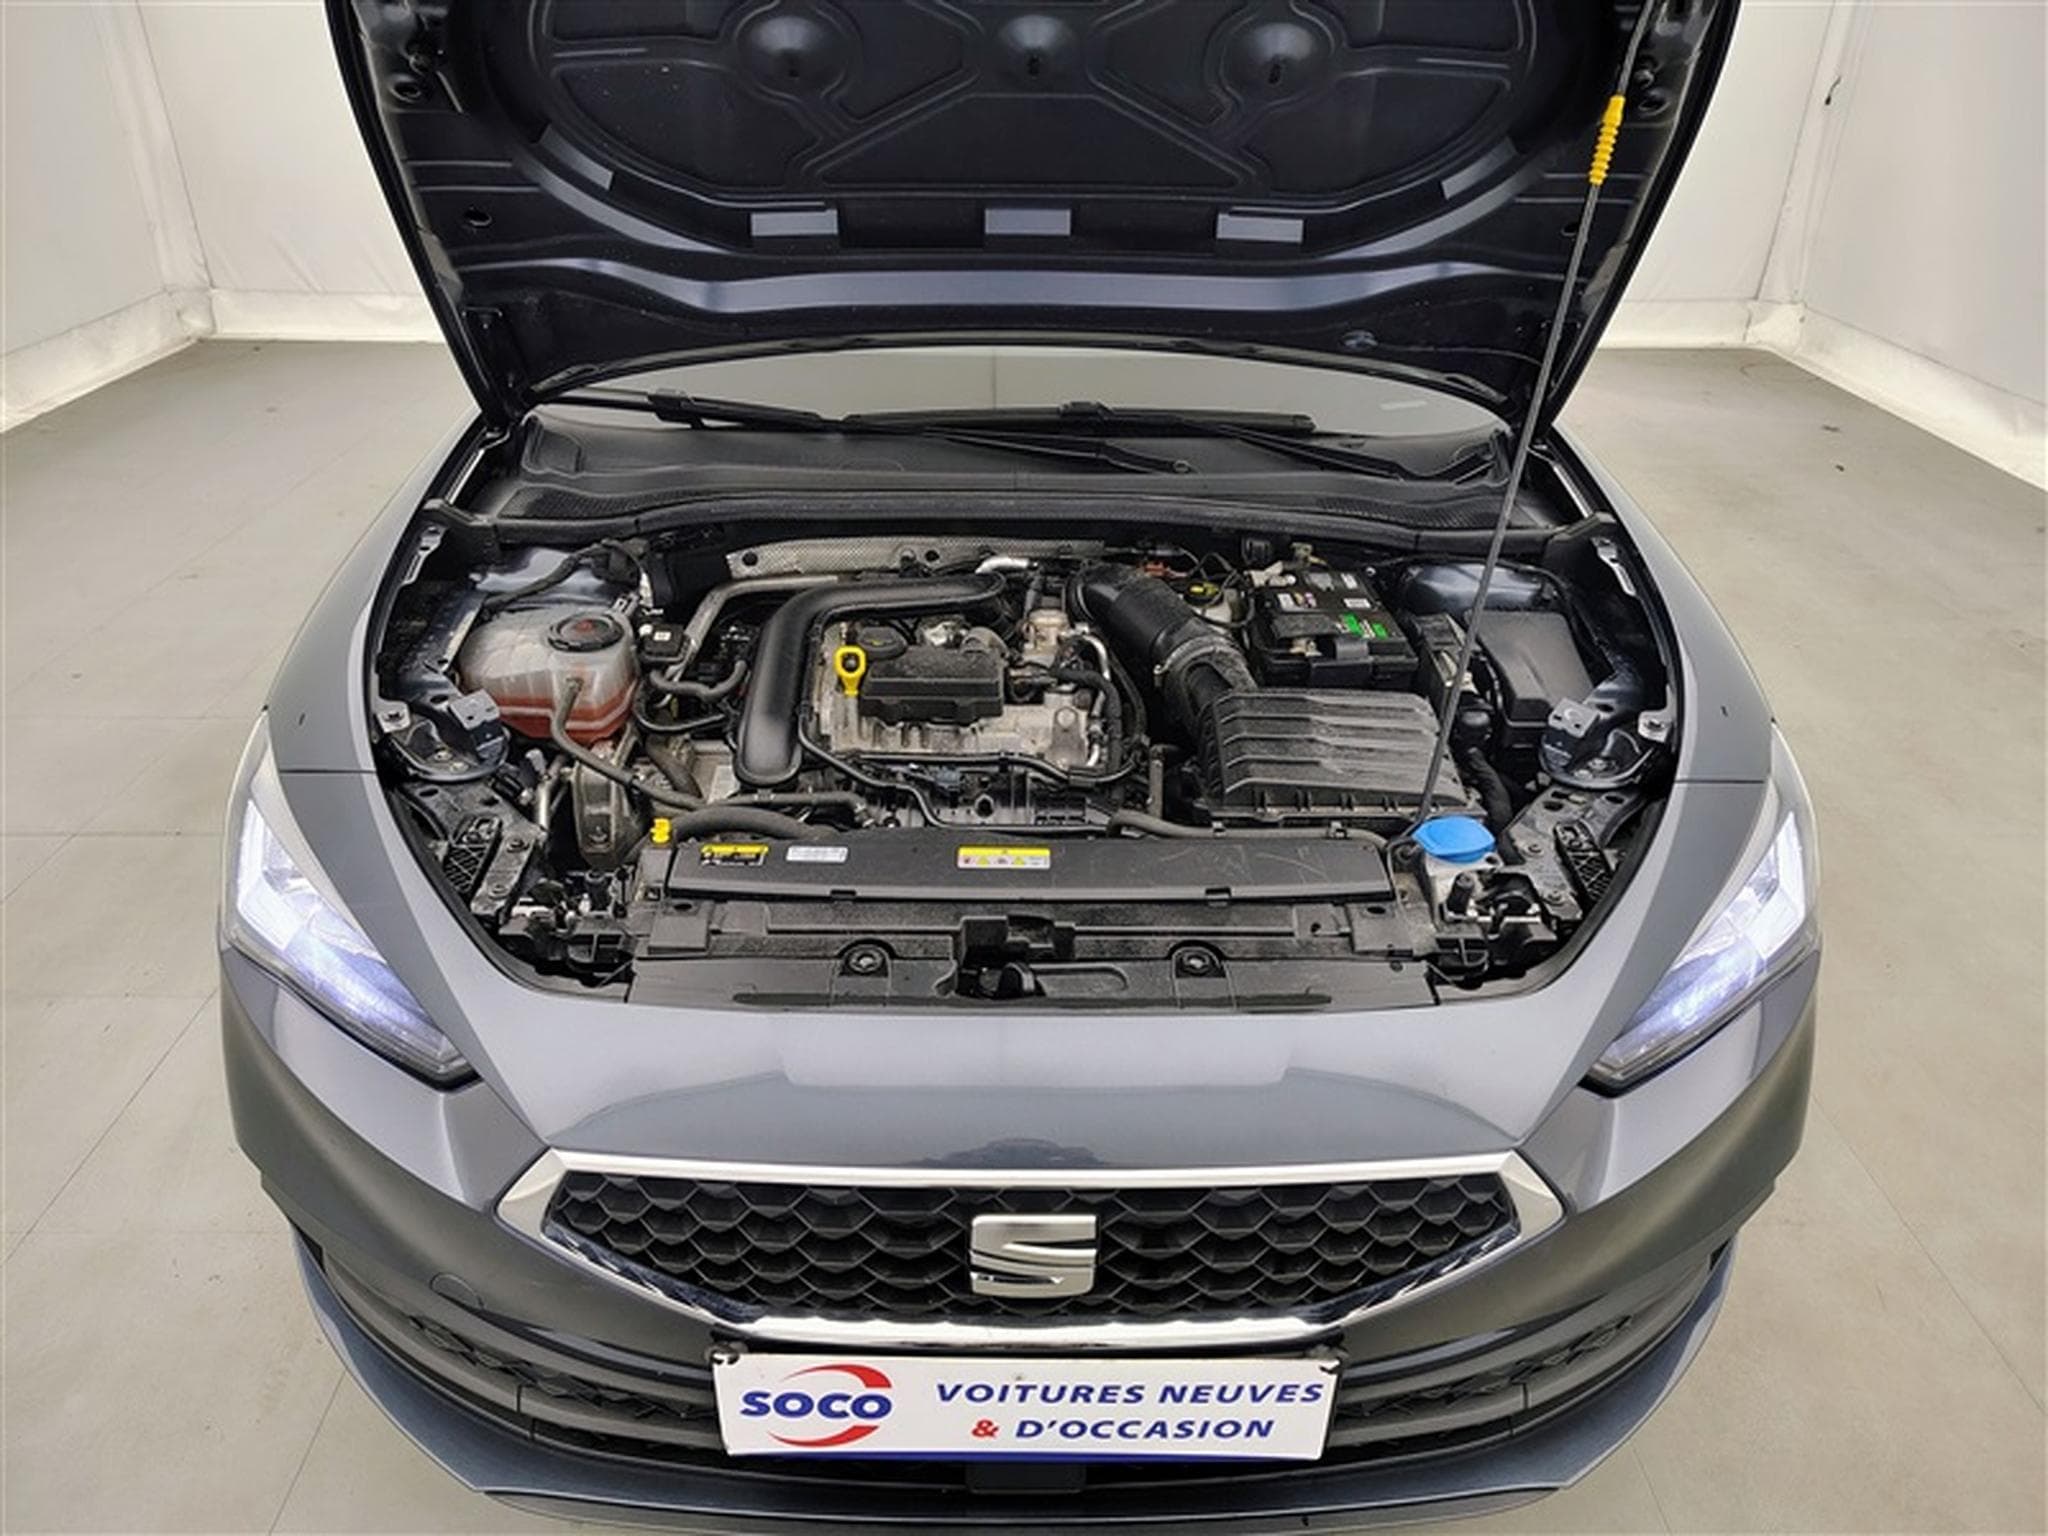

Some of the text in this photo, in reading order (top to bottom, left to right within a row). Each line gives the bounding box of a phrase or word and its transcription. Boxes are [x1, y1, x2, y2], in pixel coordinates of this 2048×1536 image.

[937, 1384, 1323, 1404] VOITURES NEUVES
[740, 1391, 893, 1420] SOCO
[971, 1419, 1274, 1440] & D'OCCASION
